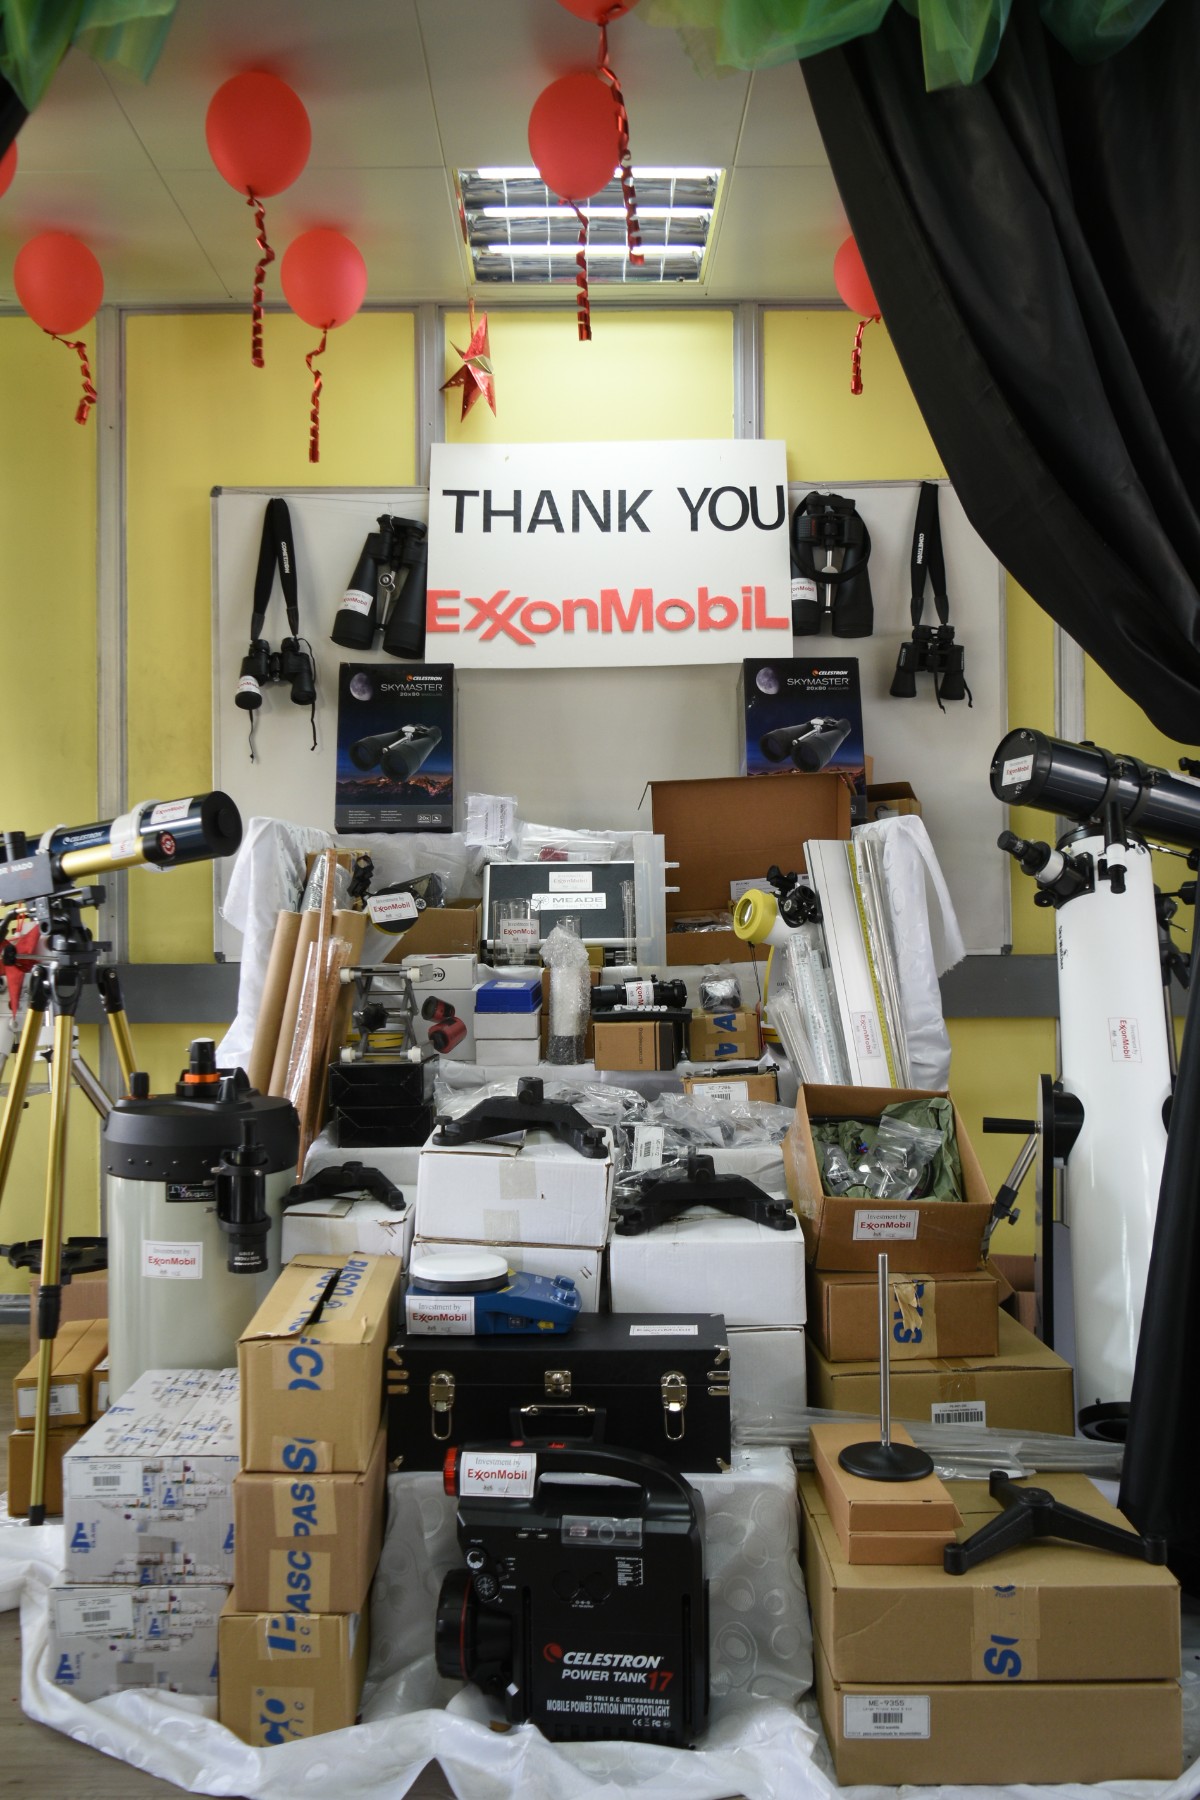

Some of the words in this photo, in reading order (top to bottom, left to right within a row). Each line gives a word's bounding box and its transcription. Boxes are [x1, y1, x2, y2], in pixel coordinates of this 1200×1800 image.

[442, 489, 653, 533] THANK
[676, 485, 786, 532] YOU
[380, 683, 443, 691] SKYMASTER
[786, 677, 849, 686] SKYMASTER
[373, 901, 411, 912] ExxonMobil
[503, 928, 537, 936] ExxonMobil
[1119, 1019, 1131, 1059] ExxonMobil
[899, 1213, 907, 1221] by
[860, 1221, 911, 1231] ExxonMobil
[148, 1256, 196, 1267] ExxonMobil
[418, 1302, 452, 1310] Investment
[453, 1303, 462, 1312] by
[412, 1312, 467, 1323] ExxonMobil
[475, 1457, 512, 1466] Investment
[513, 1458, 522, 1468] by
[467, 1468, 528, 1482] ExxonMobil
[563, 1651, 661, 1669] CELESTRON
[561, 1669, 610, 1682] POWER
[613, 1671, 648, 1684] TANK
[647, 1671, 674, 1691] 17
[623, 1697, 670, 1705] RECHARGEABLE
[546, 1699, 570, 1712] MOBILE
[570, 1701, 592, 1713] POWER
[593, 1702, 619, 1715] STATION
[619, 1703, 636, 1716] WITH
[636, 1705, 670, 1718] SPOTLIGHT
